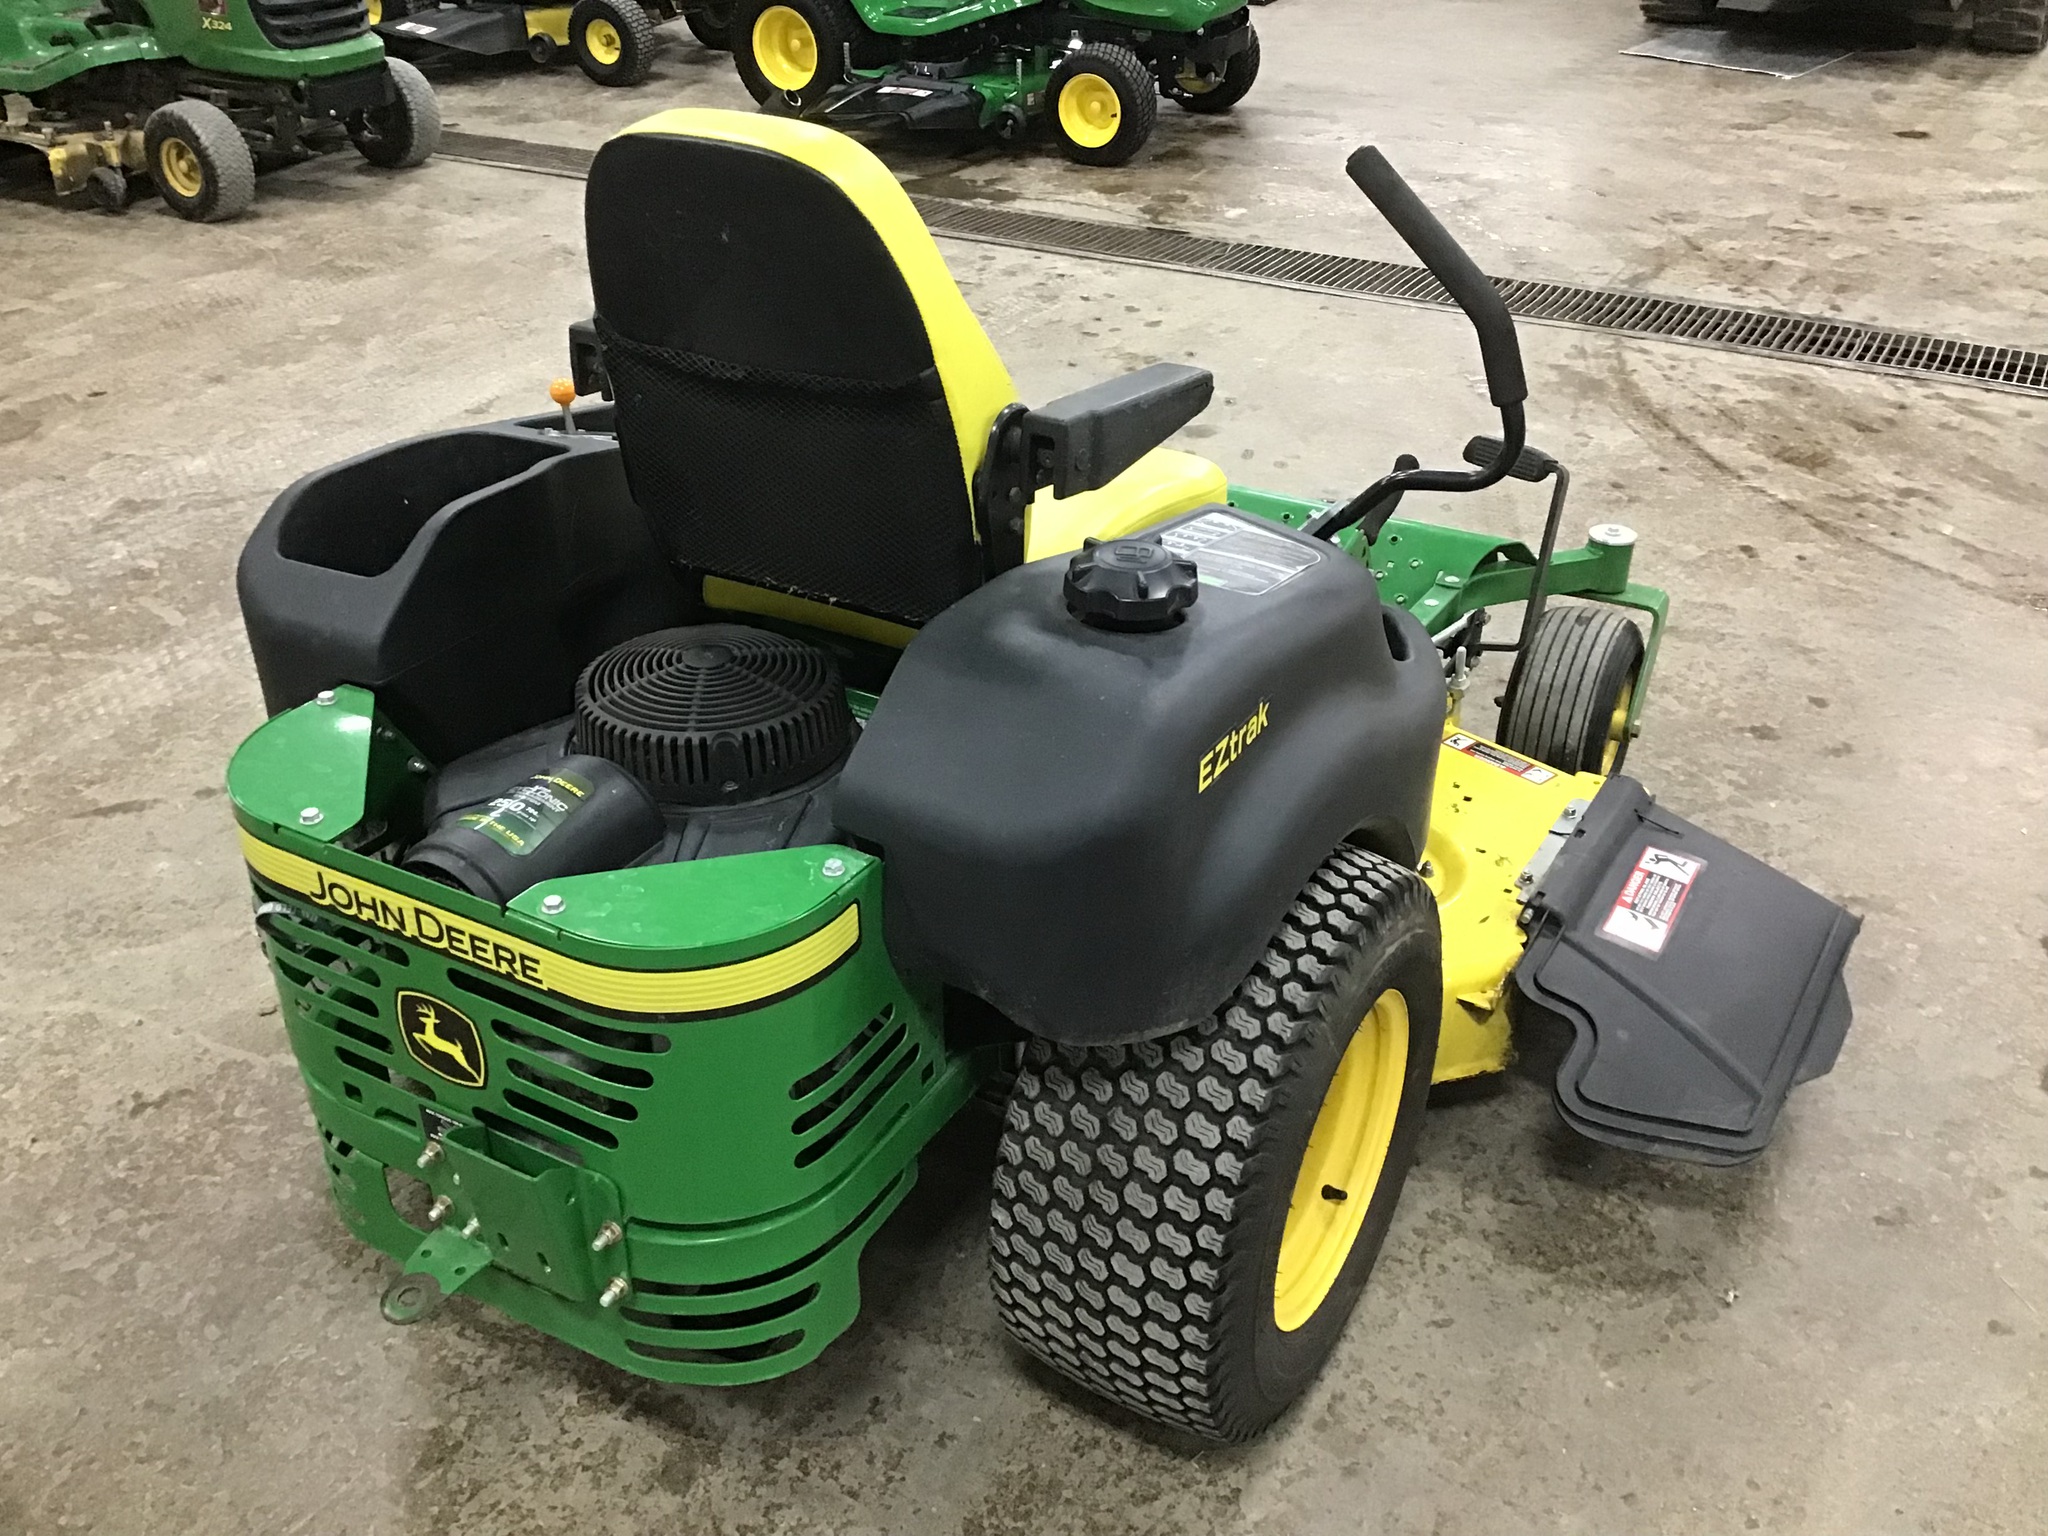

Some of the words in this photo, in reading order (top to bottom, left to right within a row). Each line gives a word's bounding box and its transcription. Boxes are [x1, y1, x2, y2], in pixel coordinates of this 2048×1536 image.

[202, 16, 233, 31] X324
[1199, 701, 1270, 794] EZtrak
[553, 777, 585, 798] DEERE
[505, 829, 525, 847] USA
[1623, 870, 1646, 898] DANGER
[310, 871, 407, 932] JOHN
[414, 906, 543, 985] DEERE
